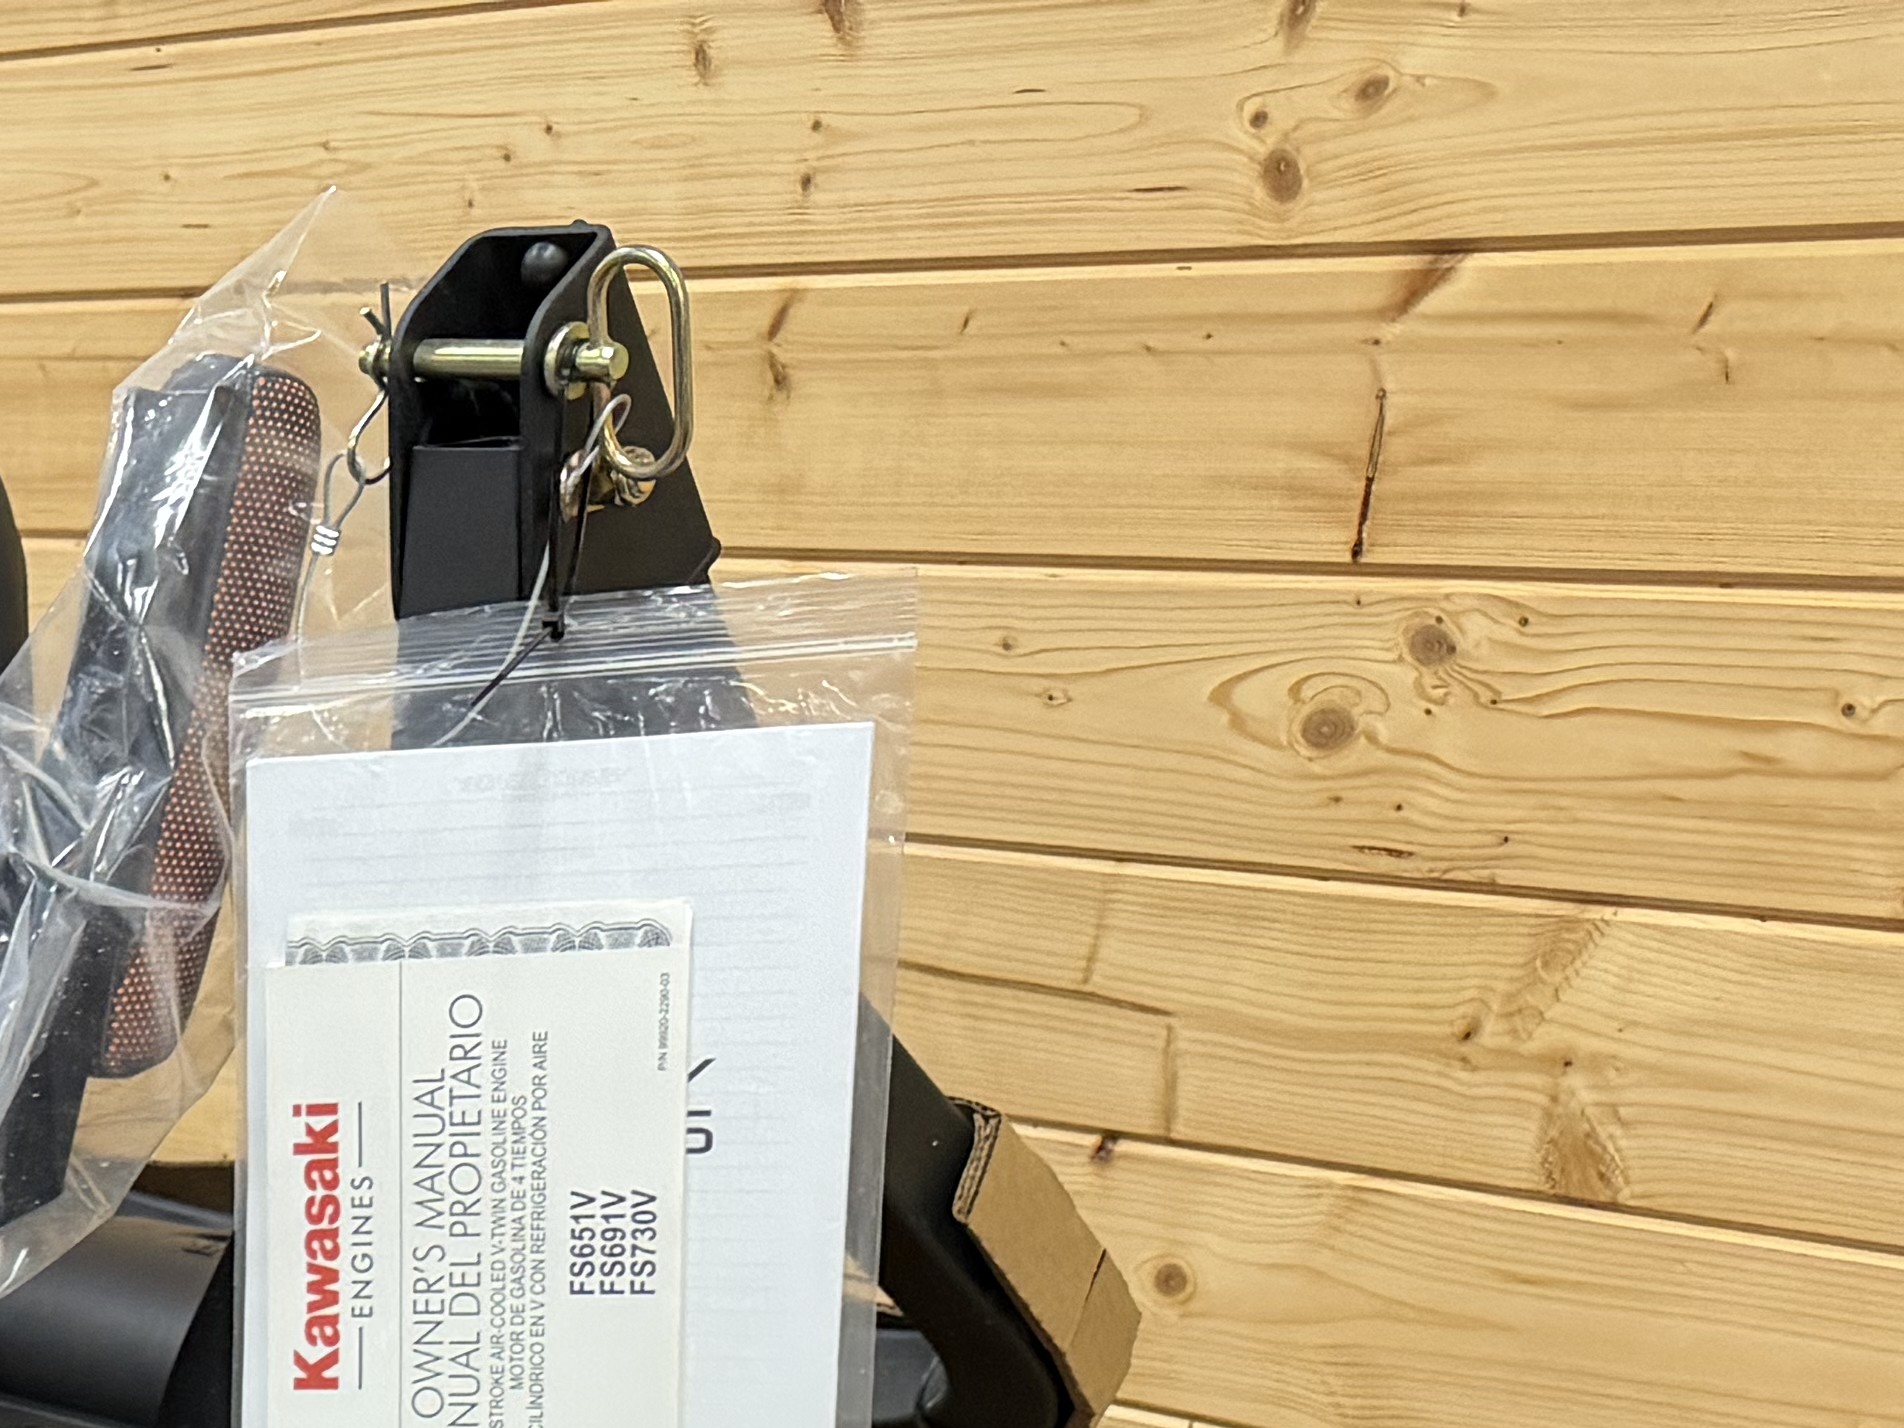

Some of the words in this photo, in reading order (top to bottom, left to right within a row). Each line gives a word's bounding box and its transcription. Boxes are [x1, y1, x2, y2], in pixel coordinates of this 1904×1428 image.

[491, 1038, 508, 1104] ENGINE
[532, 1030, 548, 1070] AIRE
[448, 993, 483, 1237] PROPIETARIO
[532, 1074, 547, 1111] POR
[412, 1068, 446, 1229] MANUAL
[491, 1109, 508, 1194] GASOLINE
[511, 1094, 527, 1173] TIEMPOS
[490, 1198, 507, 1257] V-TWIN
[511, 1191, 526, 1212] DE
[600, 1189, 626, 1295] FS691V
[630, 1189, 657, 1295] FS730V
[292, 1102, 341, 1390] Kawasaki
[351, 1175, 374, 1318] ENGINES
[510, 1216, 526, 1300] GASOLINA
[530, 1258, 545, 1294] CON
[569, 1190, 596, 1295] FS651V
[448, 1252, 481, 1316] DEL
[490, 1259, 506, 1361] AIR-COOLED
[510, 1304, 525, 1327] DE
[411, 1244, 446, 1418] OWNER'S
[509, 1331, 525, 1390] MOTOR
[529, 1321, 545, 1340] EN
